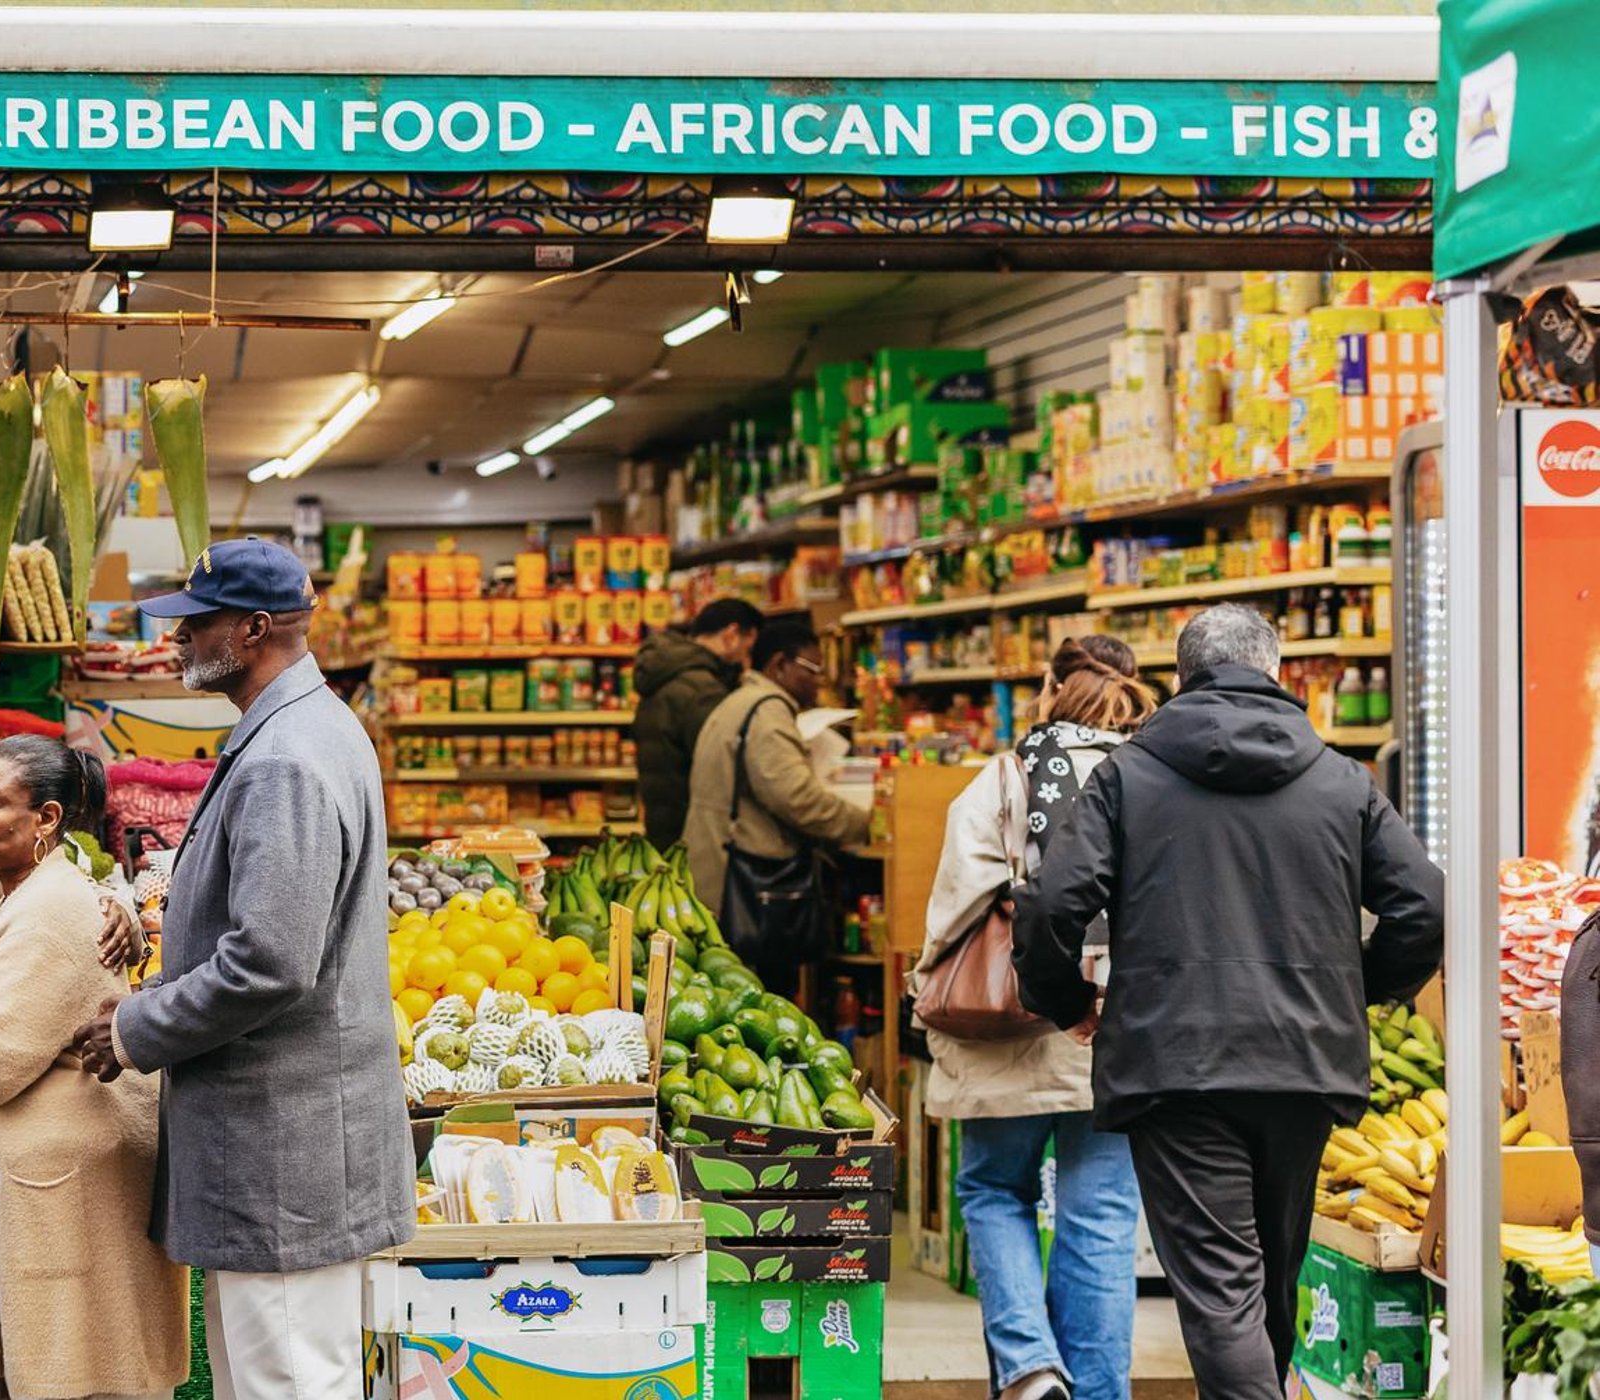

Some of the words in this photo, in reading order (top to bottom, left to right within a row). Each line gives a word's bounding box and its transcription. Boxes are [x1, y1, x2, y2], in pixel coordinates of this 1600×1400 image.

[343, 101, 544, 151] FOOD
[617, 104, 929, 155] AFRICAN
[960, 104, 1156, 155] FOOD
[1233, 106, 1379, 157] FISH
[1405, 108, 1437, 158] &
[517, 1294, 557, 1307] AZARA
